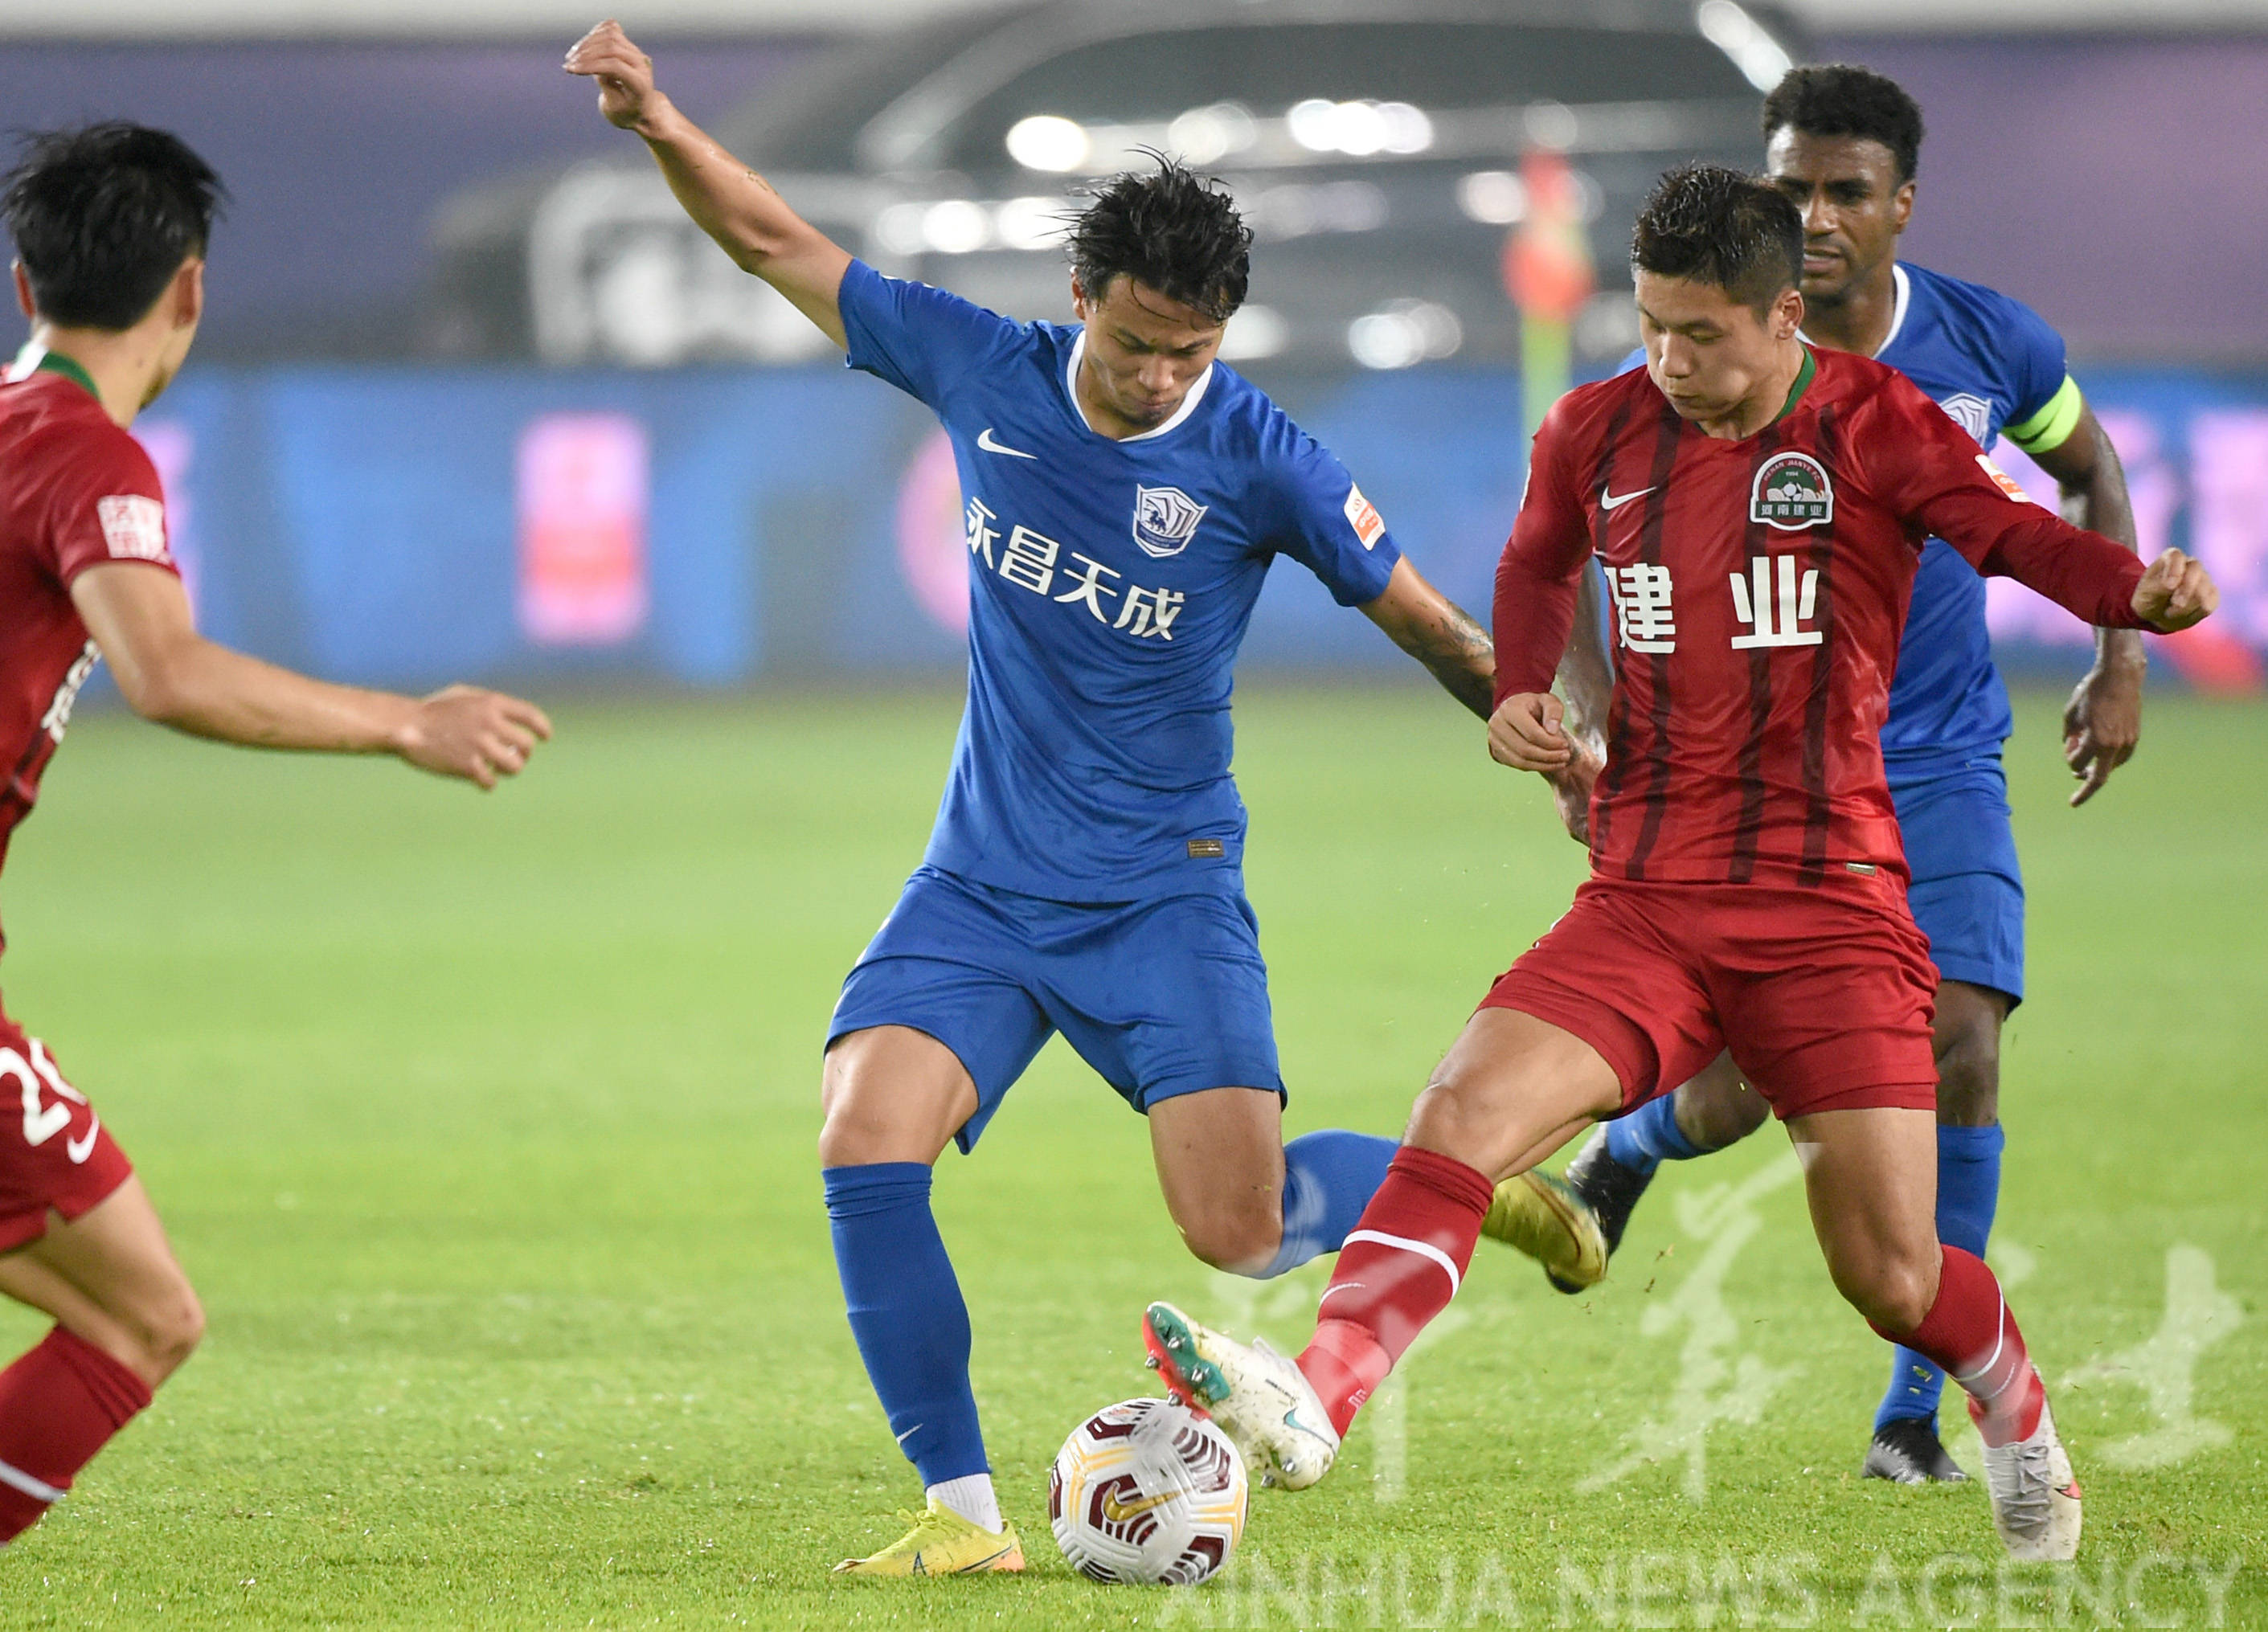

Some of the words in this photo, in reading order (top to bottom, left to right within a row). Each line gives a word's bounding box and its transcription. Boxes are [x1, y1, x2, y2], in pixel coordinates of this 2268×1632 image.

[966, 497, 1185, 640] 永昌天成
[1603, 555, 1824, 653] 建业
